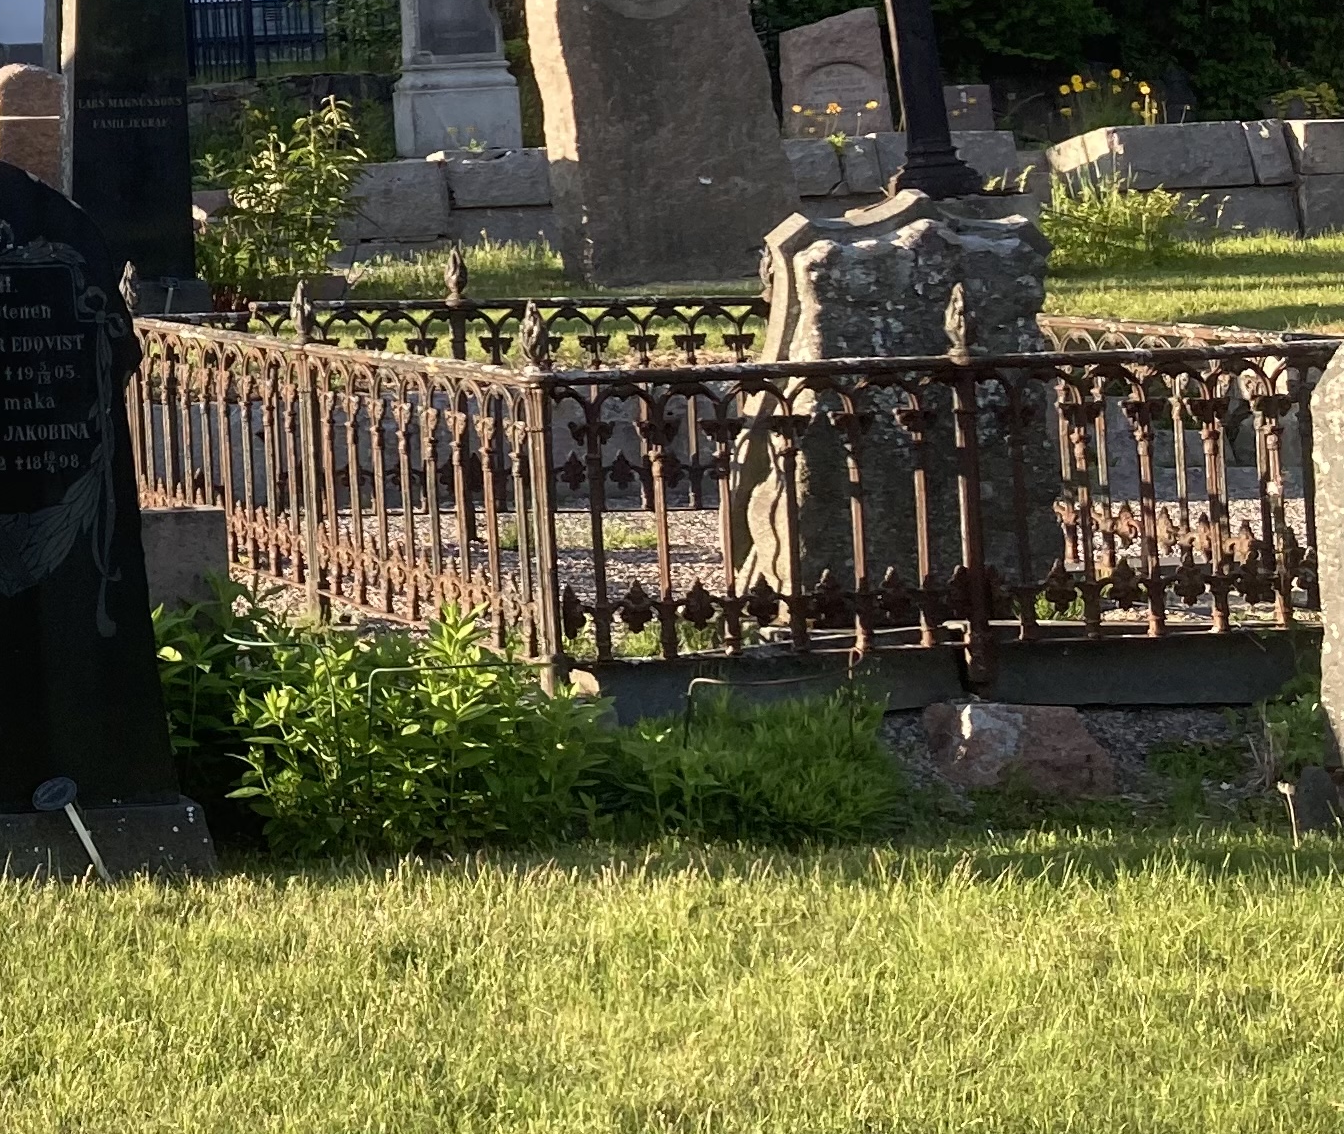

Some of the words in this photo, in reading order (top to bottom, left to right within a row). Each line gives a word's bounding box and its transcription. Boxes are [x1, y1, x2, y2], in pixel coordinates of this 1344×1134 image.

[11, 333, 85, 355] EDQVIST
[3, 392, 56, 411] maka
[3, 422, 91, 443] JAKOBINA
